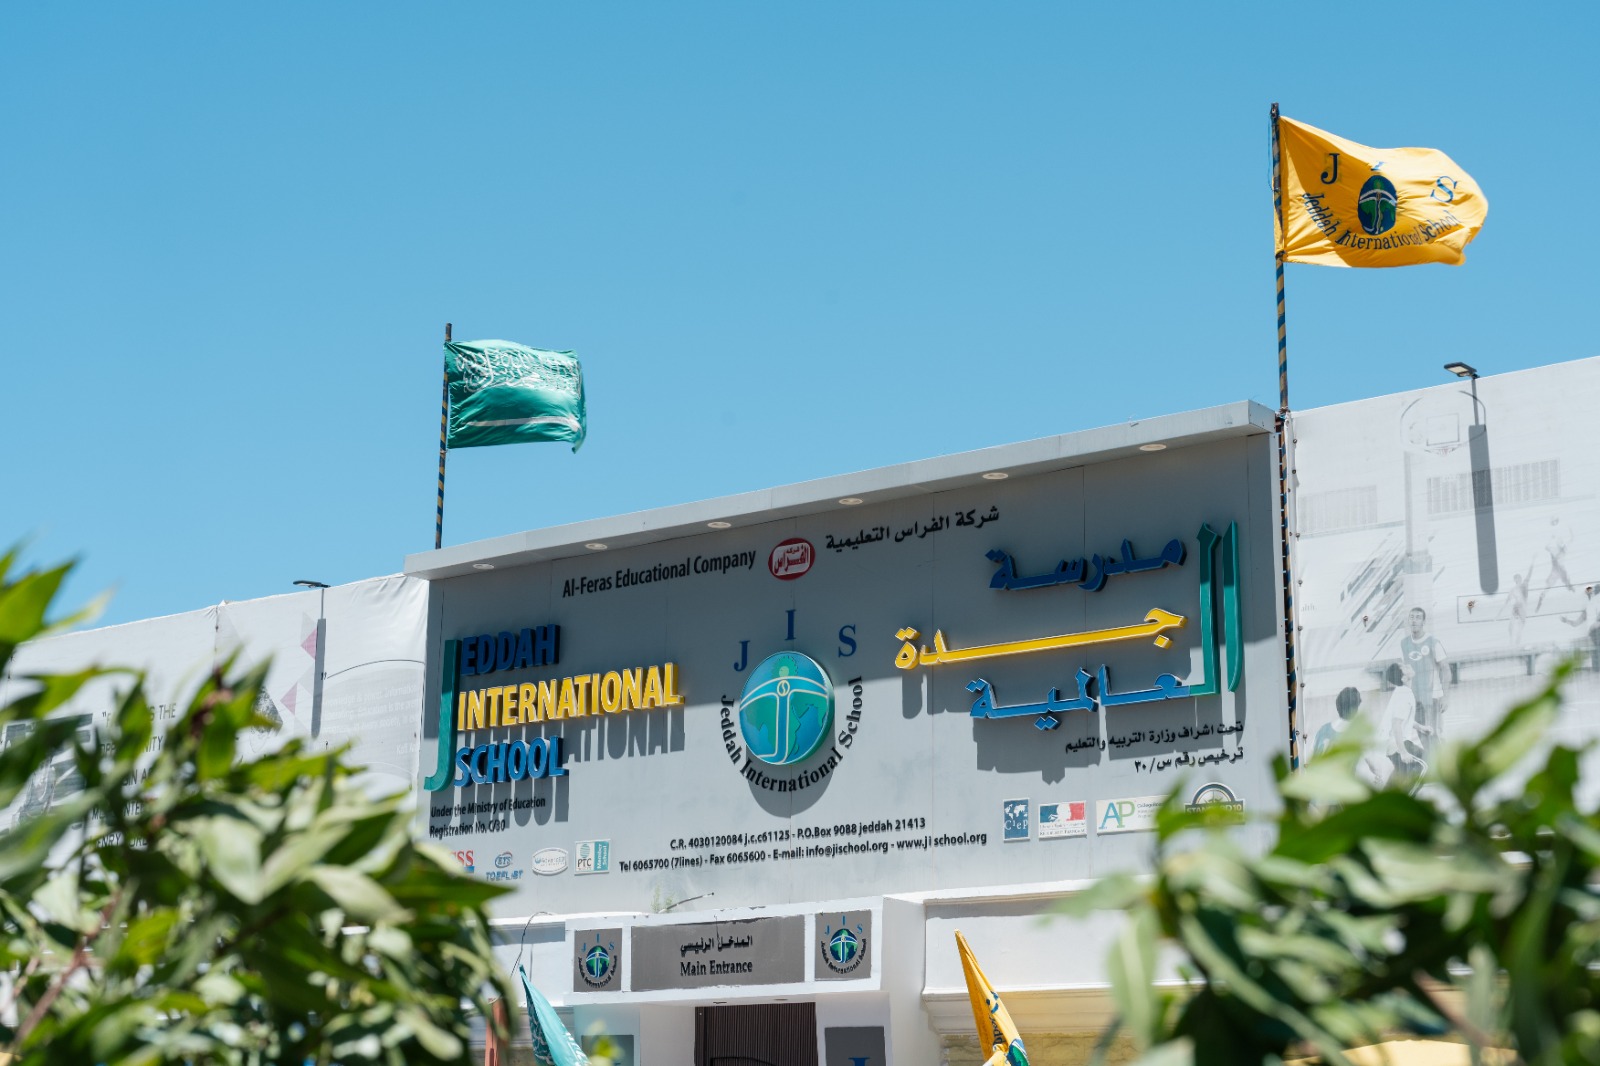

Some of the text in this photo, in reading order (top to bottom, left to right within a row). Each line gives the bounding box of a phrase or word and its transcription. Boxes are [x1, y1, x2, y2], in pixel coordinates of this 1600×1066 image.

[1321, 153, 1340, 185] J
[1430, 175, 1458, 203] S
[825, 506, 1000, 553] شركة الفراس التعليمية
[562, 550, 756, 598] Al-Feras Educational Company
[985, 537, 1188, 592] مدرسة
[734, 609, 858, 673] J I S
[457, 662, 686, 731] INTERNATIONAL
[159, 703, 176, 720] THE
[720, 676, 864, 793] Jeddah International School
[1148, 728, 1176, 745] وزارة
[1178, 724, 1215, 739] اشراف
[1216, 721, 1244, 734] تحت
[1065, 736, 1106, 754] والتعليم
[1197, 747, 1244, 765] ترخيص
[454, 735, 570, 788] SCHOOL
[431, 796, 546, 818] Under the Ministry of Education
[1100, 801, 1136, 829] AP
[430, 822, 473, 840] Registration
[670, 839, 687, 850] C.R.
[688, 834, 743, 849] 4030120084
[797, 826, 831, 839] P.O.Box
[833, 823, 857, 836] 9088
[858, 819, 893, 836] jeddah
[895, 817, 926, 831] 21413
[577, 858, 591, 867] PTC
[619, 860, 631, 872] Tel
[633, 857, 669, 870] 6065700
[671, 855, 703, 869] (7lines)
[709, 853, 725, 866] Fax
[727, 850, 766, 864] 6065600
[773, 846, 805, 860] E-mail:
[805, 840, 888, 858] info@jischool.org
[680, 935, 753, 957] المدخل الرئيسي
[680, 959, 753, 976] Main Entrance
